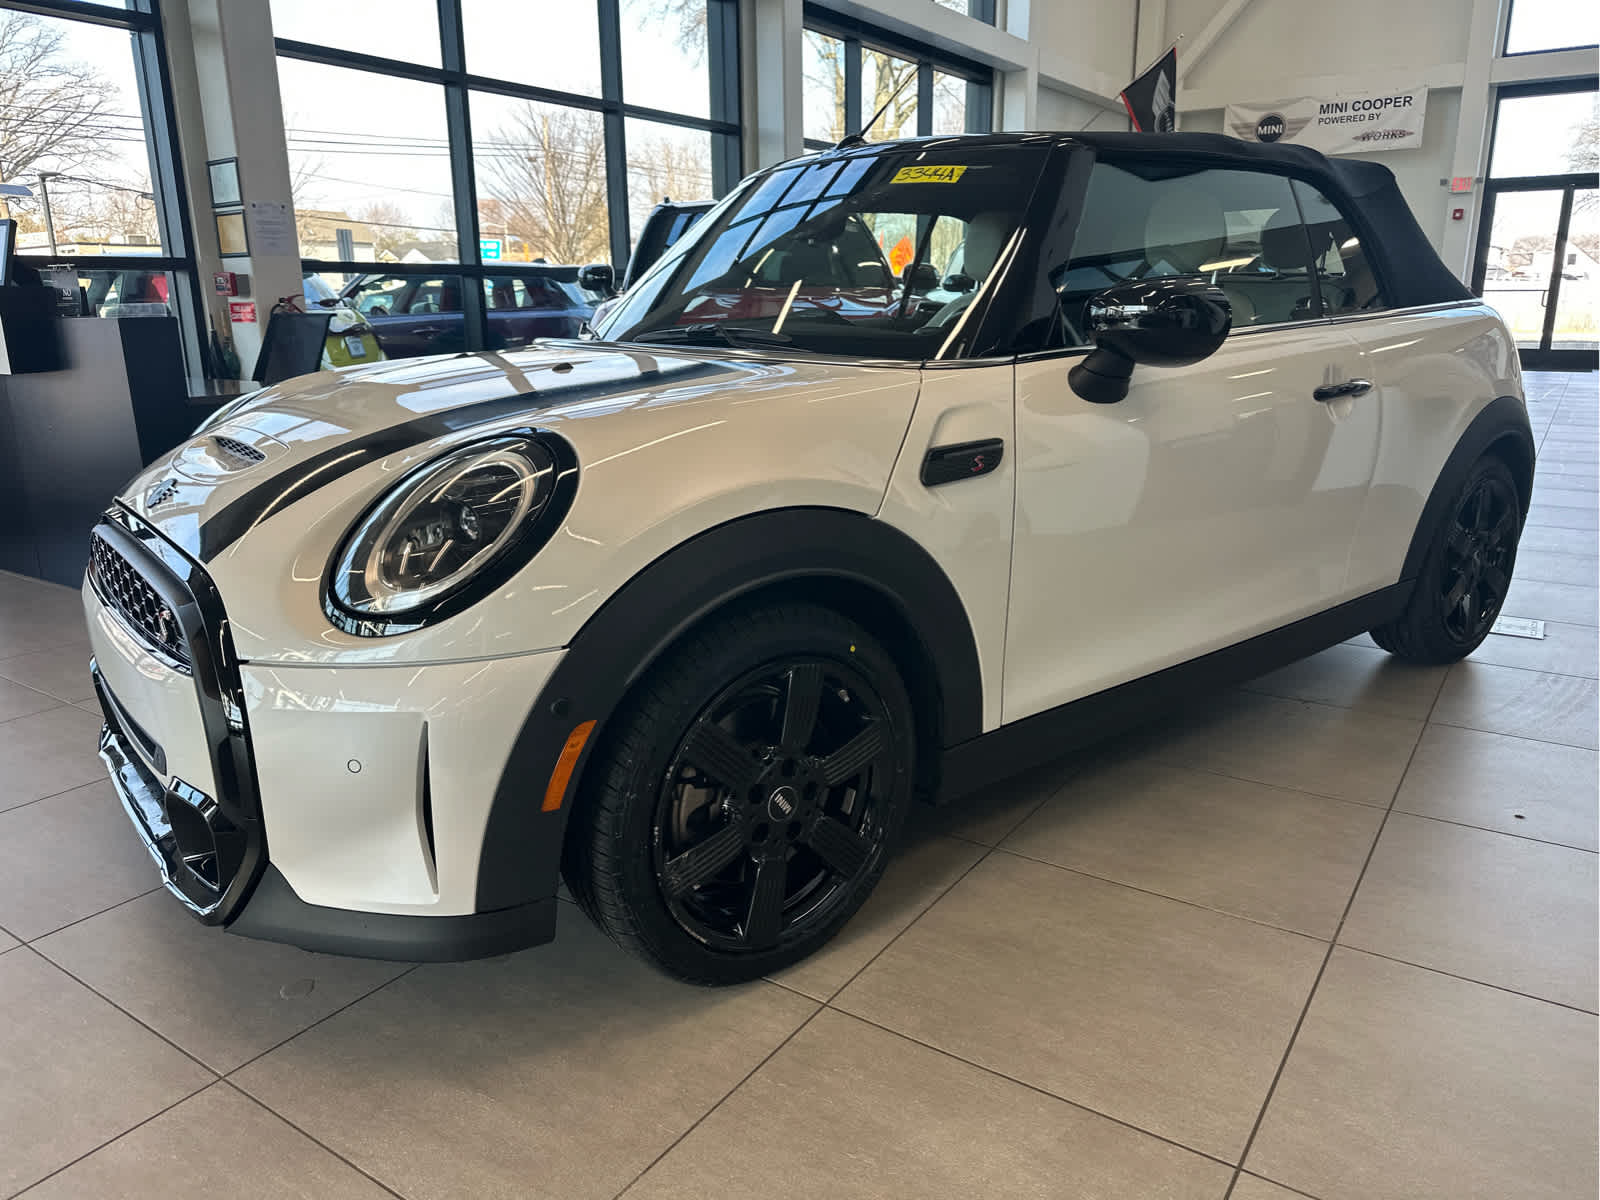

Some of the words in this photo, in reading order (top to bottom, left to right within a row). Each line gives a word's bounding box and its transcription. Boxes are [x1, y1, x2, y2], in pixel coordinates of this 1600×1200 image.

[1319, 102, 1348, 115] MINI
[1351, 95, 1413, 112] COOPER
[1318, 114, 1365, 125] POWERED
[1368, 112, 1382, 121] BY
[1257, 124, 1283, 136] MINI
[971, 455, 985, 472] S
[774, 793, 793, 815] MINI
